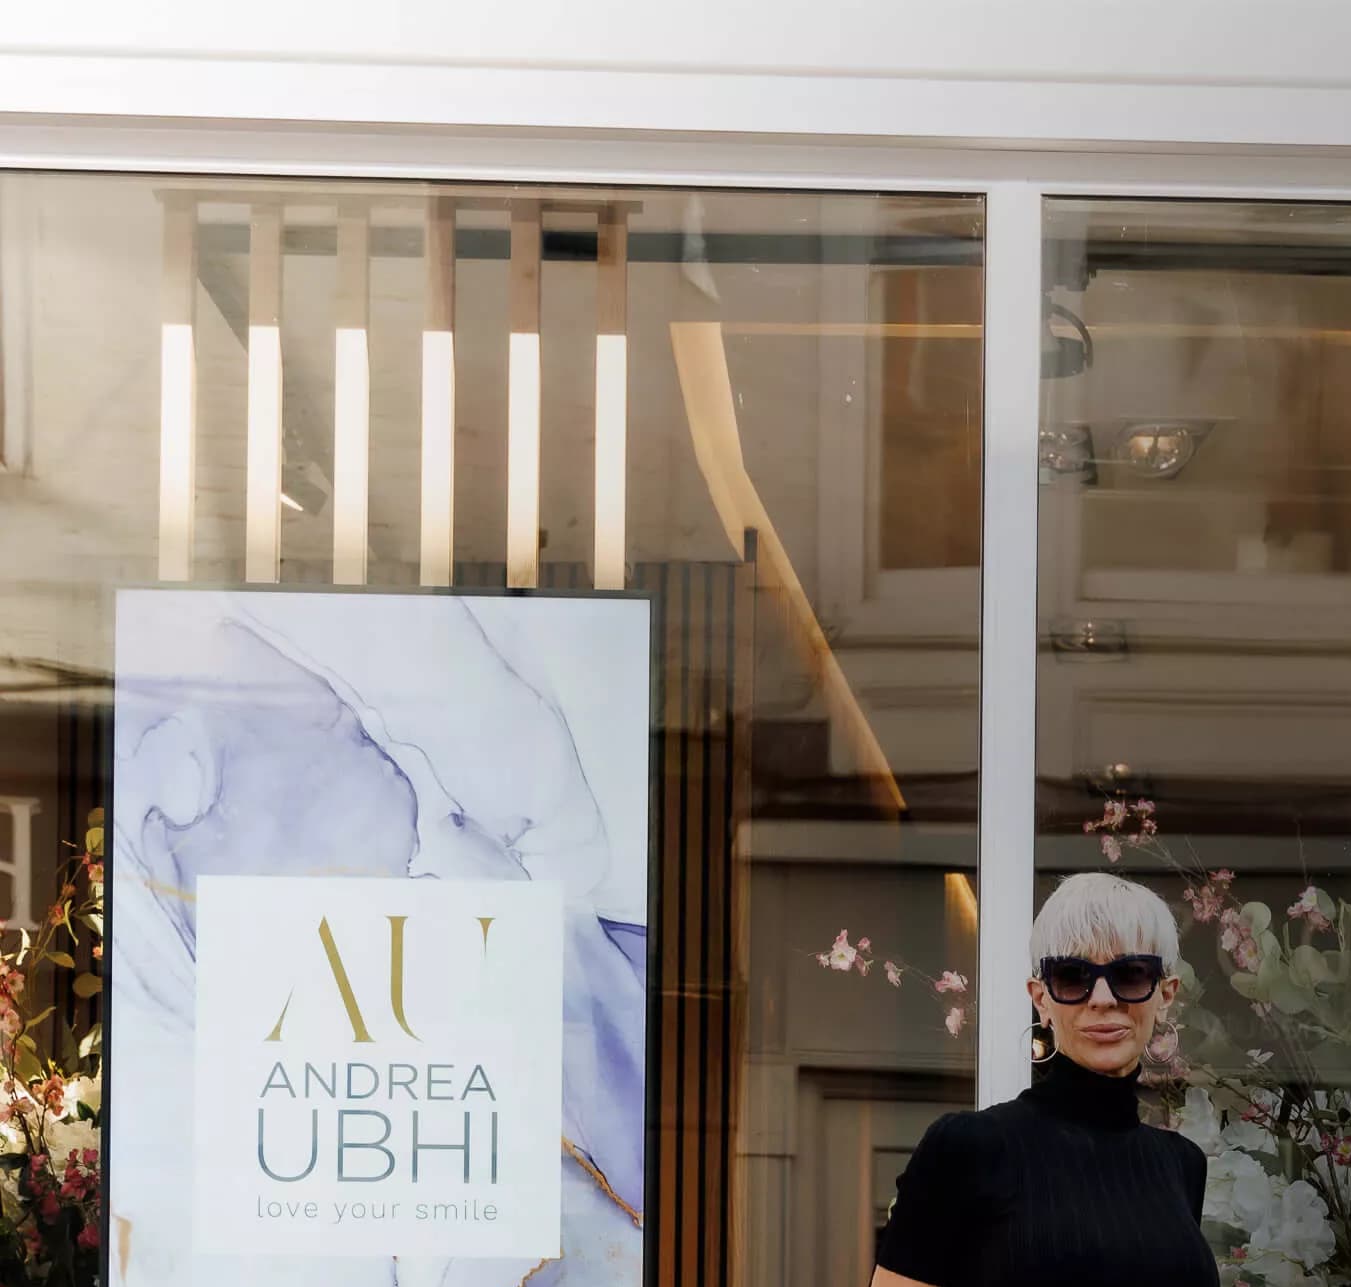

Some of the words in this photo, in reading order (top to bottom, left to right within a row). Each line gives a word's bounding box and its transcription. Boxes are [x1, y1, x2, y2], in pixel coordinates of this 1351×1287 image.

[260, 1061, 497, 1101] ANDREA
[257, 1108, 498, 1184] UBHI
[257, 1196, 318, 1218] love
[333, 1202, 401, 1224] your
[415, 1200, 498, 1221] smile
